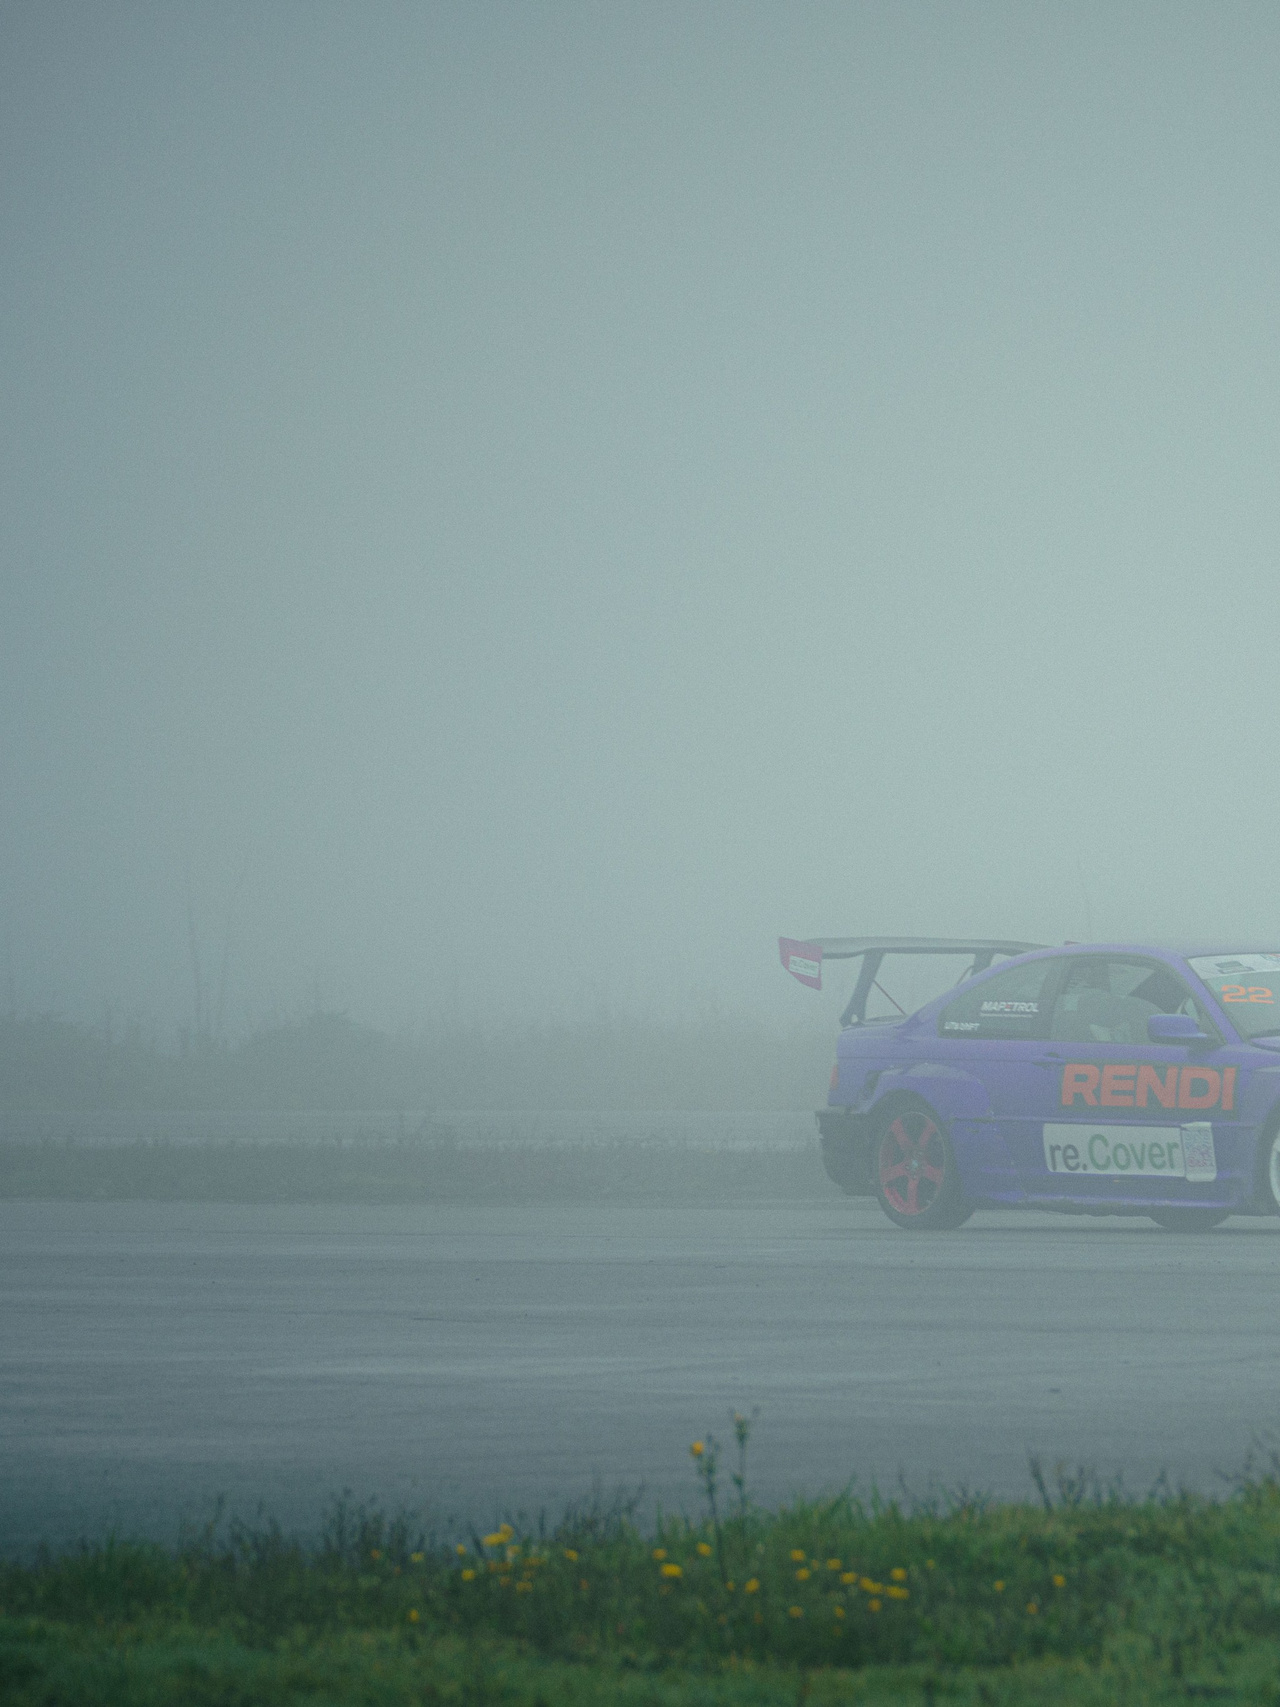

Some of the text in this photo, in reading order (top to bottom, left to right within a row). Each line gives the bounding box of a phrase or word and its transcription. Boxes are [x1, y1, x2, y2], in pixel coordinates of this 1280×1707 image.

[1221, 984, 1274, 1004] 22
[1061, 1063, 1237, 1111] RENDI
[1049, 1133, 1180, 1172] re.Cover
